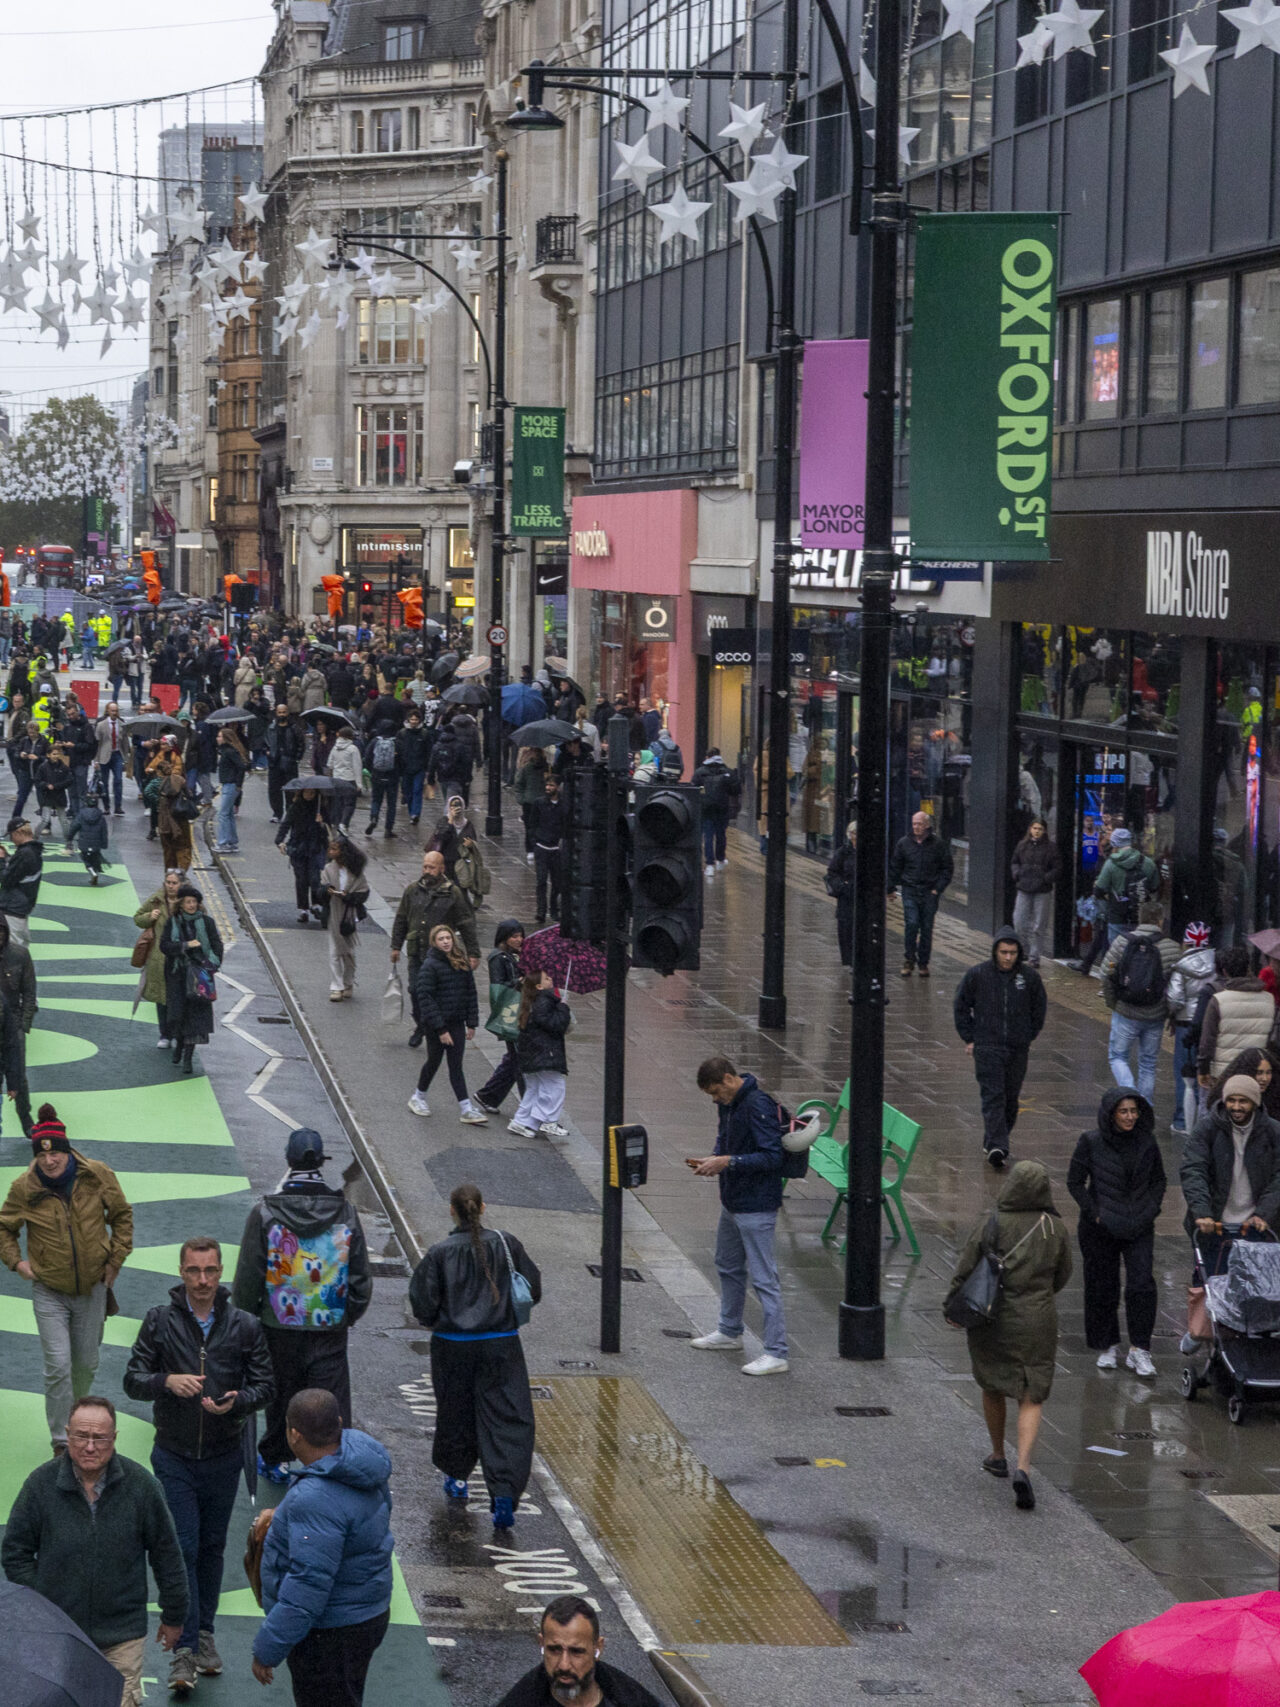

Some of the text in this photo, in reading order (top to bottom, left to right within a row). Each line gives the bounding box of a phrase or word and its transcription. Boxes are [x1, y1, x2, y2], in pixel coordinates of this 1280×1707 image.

[996, 238, 1053, 494] OXFORD
[521, 415, 559, 427] MORE
[521, 426, 558, 438] SPACE
[524, 504, 551, 516] LESS
[803, 504, 865, 519] MAYOR
[513, 515, 562, 528] TRAFFIC
[803, 519, 865, 534] LONDO
[1145, 530, 1230, 620] NBA Store
[492, 631, 506, 640] 20
[715, 652, 752, 663] ecco
[482, 1544, 602, 1613] LOOK
